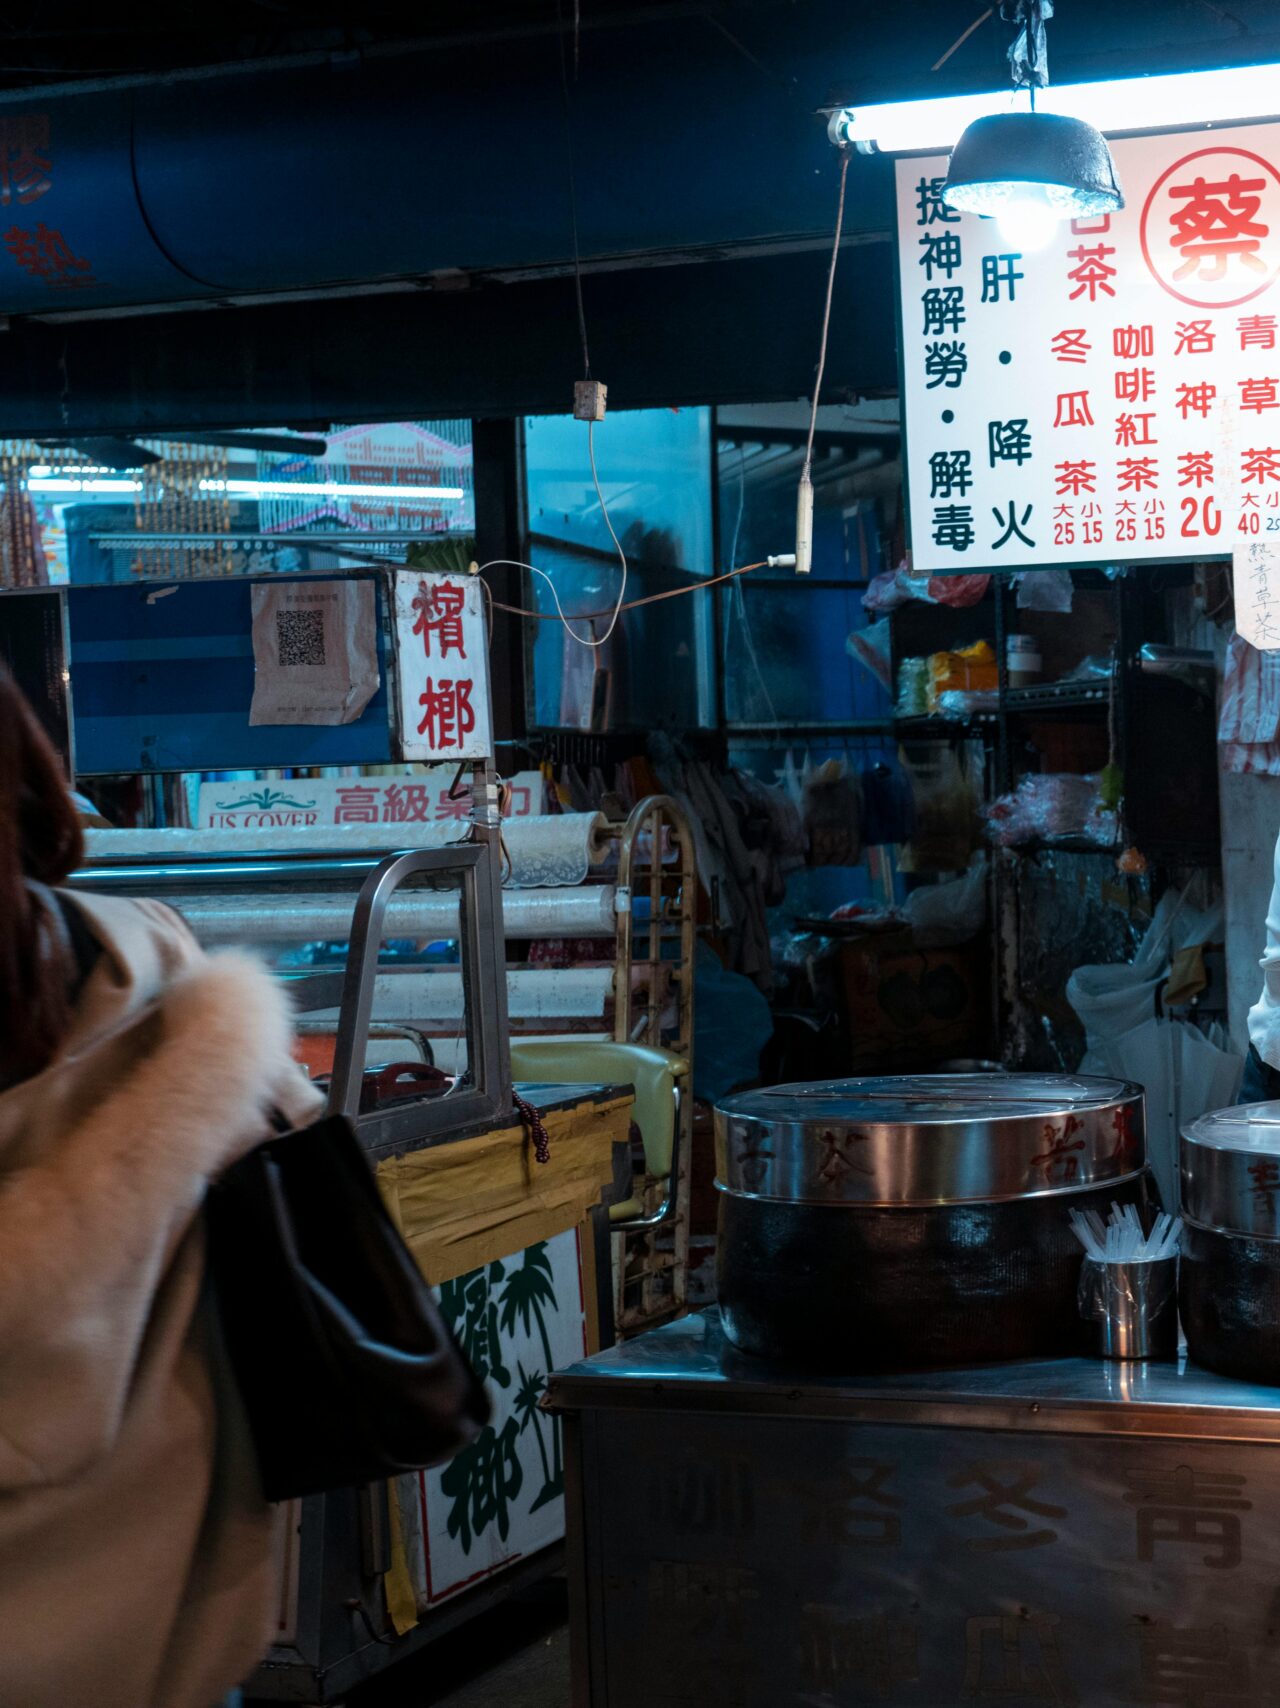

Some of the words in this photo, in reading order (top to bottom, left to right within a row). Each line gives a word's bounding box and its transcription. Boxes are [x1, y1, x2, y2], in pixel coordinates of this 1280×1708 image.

[1168, 173, 1270, 283] 蔡
[976, 210, 1037, 551] 肝・降火
[1051, 328, 1097, 497] 冬瓜茶
[1112, 324, 1160, 493] 咖啡紅茶
[1174, 319, 1217, 488] 洛神茶
[1053, 503, 1075, 520] 大
[1080, 502, 1103, 518] 小
[1115, 499, 1137, 516] 大
[1143, 497, 1166, 515] 小
[1180, 495, 1222, 538] 20
[1241, 491, 1261, 509] 大
[1053, 521, 1076, 546] 25
[1081, 520, 1104, 544] 15
[1115, 518, 1137, 542] 25
[1144, 516, 1166, 540] 15
[1237, 511, 1261, 536] 40
[411, 579, 476, 751] 檳榔
